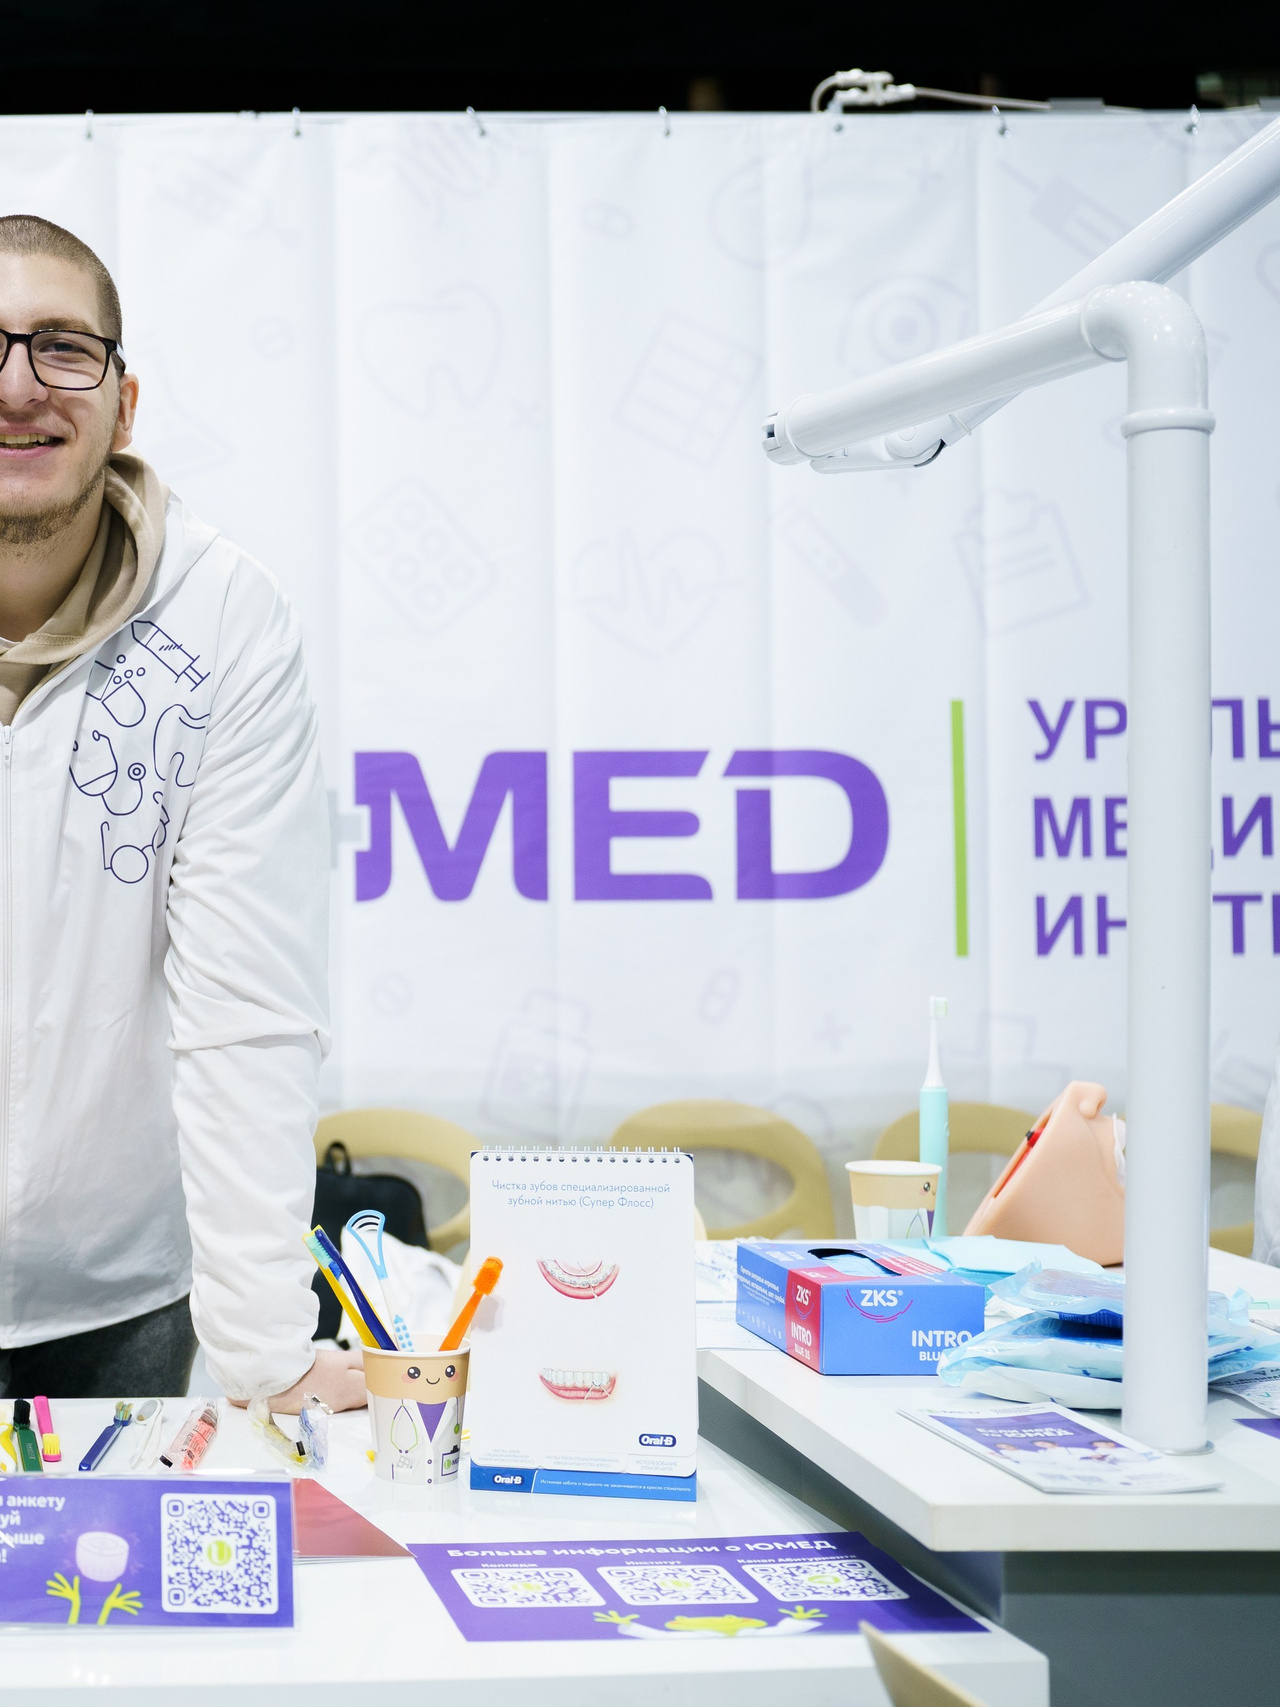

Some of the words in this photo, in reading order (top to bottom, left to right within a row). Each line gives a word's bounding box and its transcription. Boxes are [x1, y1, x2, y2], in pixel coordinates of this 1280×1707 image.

[1027, 698, 1280, 760] УРЛЬ
[1033, 796, 1273, 858] МЕИ
[491, 1180, 526, 1192] Чистка
[529, 1180, 558, 1193] зубов
[561, 1182, 670, 1194] специализированной
[507, 1196, 543, 1207] зубной
[545, 1198, 576, 1206] нитью
[579, 1196, 614, 1208] (Супер
[618, 1197, 654, 1209] Флосс)
[791, 1321, 812, 1347] INTRO
[911, 1330, 973, 1347] INTRO
[919, 1351, 943, 1361] BLU
[640, 1435, 674, 1446] Oral-B
[494, 1474, 522, 1484] Oral-B
[6, 1494, 65, 1511] анкету
[553, 1546, 720, 1556] информации
[744, 1540, 837, 1551] ЮМЕД
